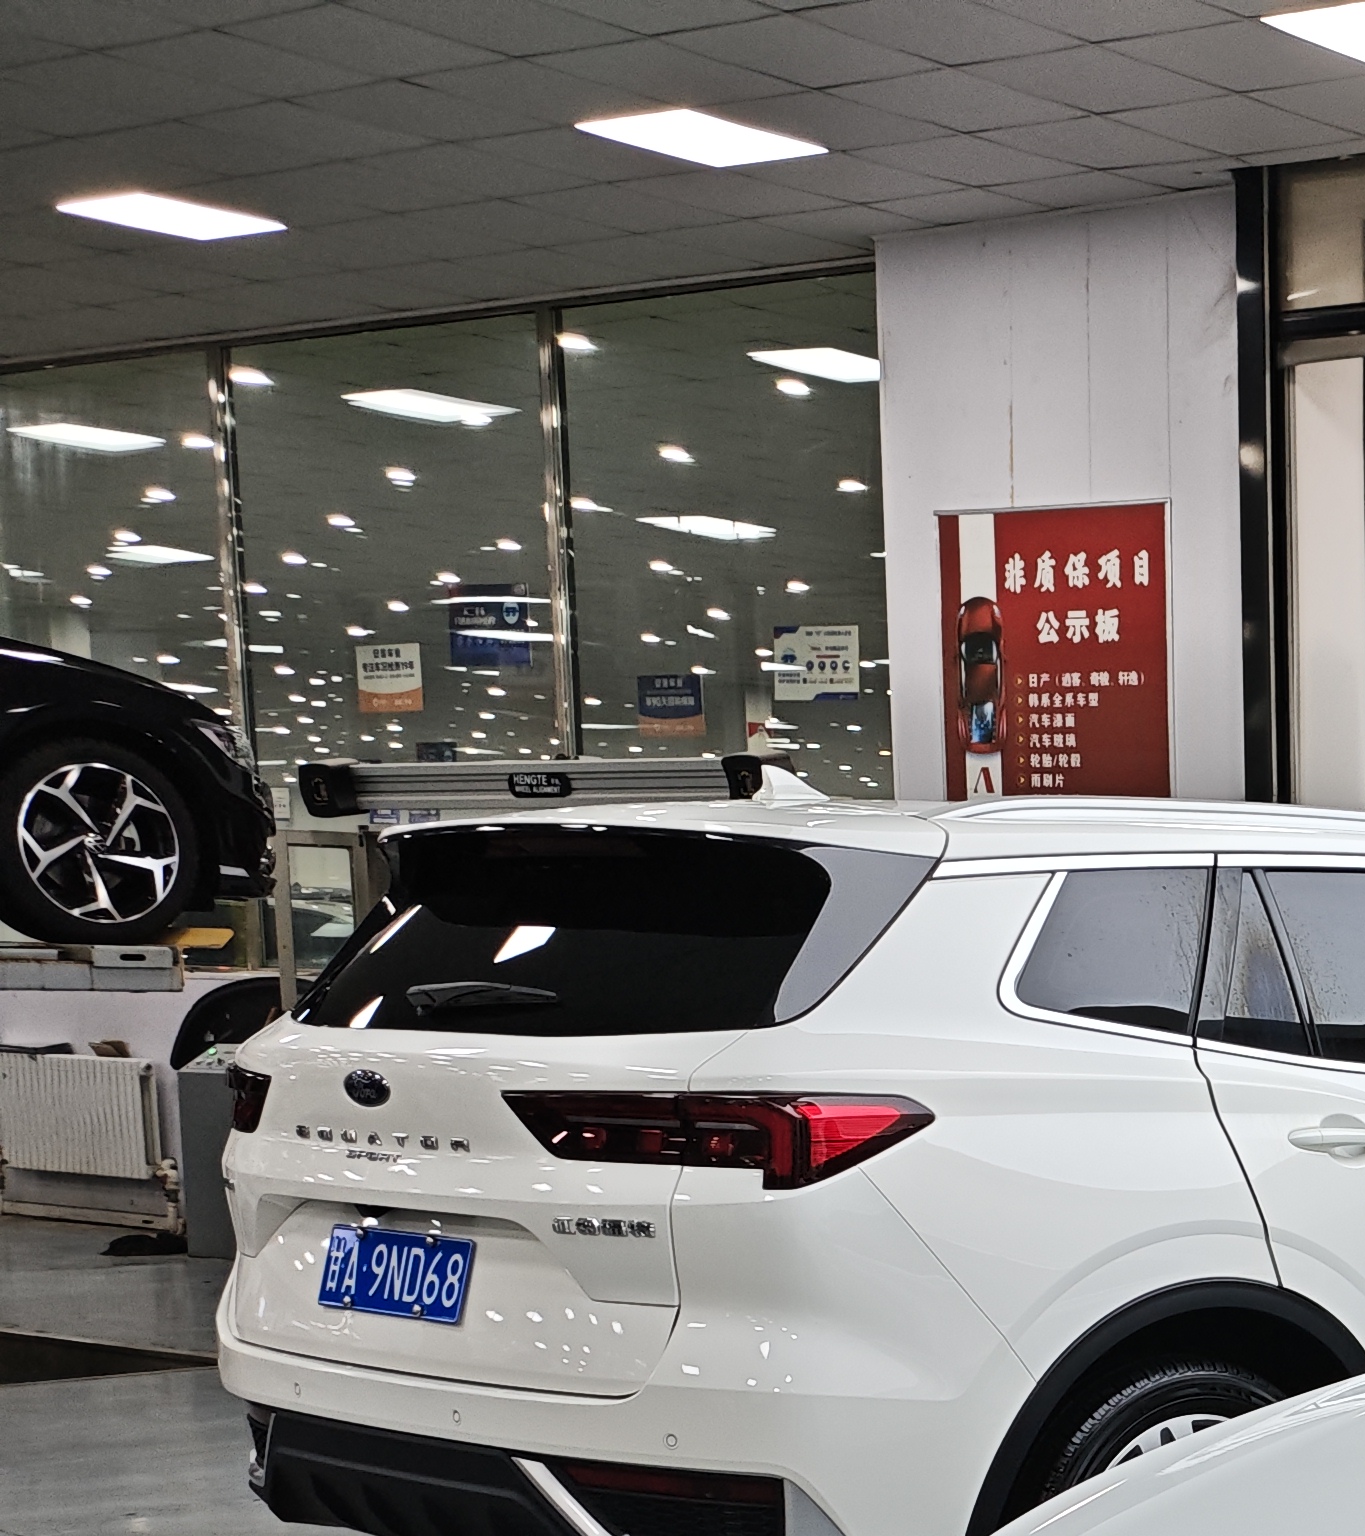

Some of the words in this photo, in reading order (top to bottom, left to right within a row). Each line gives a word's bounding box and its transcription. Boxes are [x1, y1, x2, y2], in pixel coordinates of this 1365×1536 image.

[1004, 548, 1151, 594] 非质保项目
[1037, 608, 1121, 644] 公示板
[513, 774, 548, 785] HENGTE
[296, 1124, 471, 1153] EQUATOR
